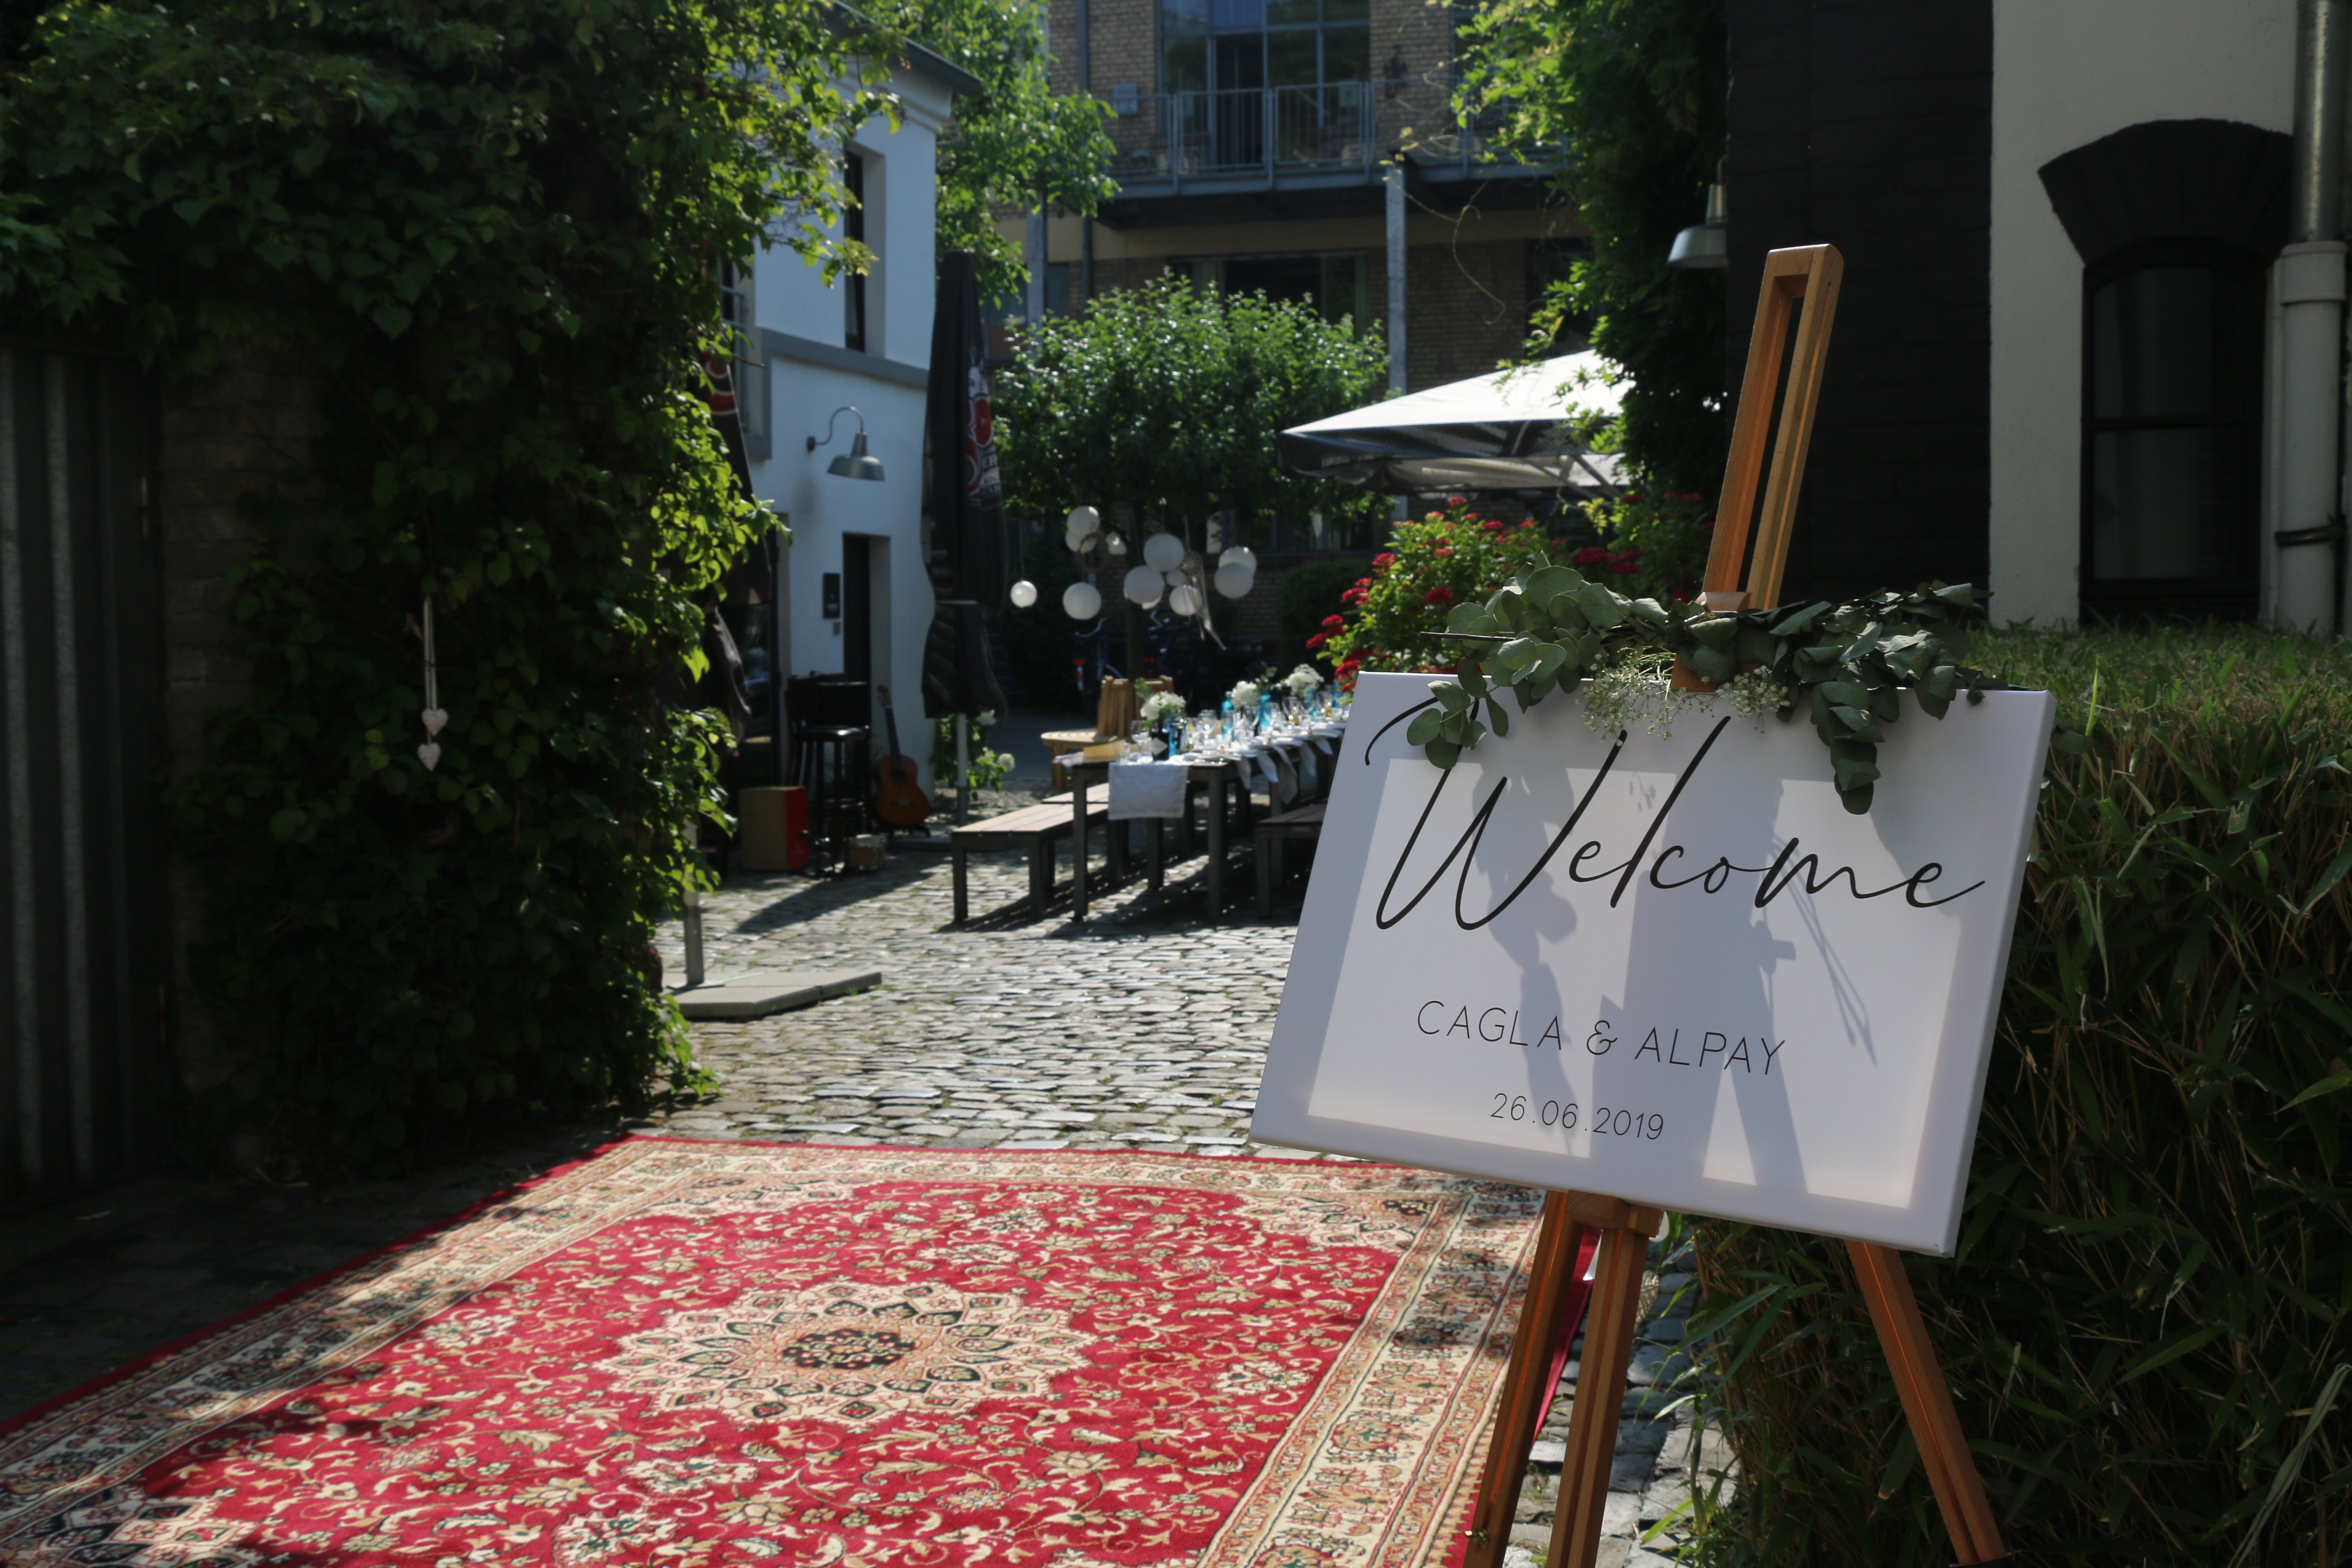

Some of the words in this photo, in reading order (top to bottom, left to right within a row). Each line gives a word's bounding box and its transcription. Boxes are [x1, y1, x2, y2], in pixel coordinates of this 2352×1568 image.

[1365, 696, 1985, 931] Welcome
[1418, 1000, 1562, 1050] CAGLA
[1586, 1020, 1618, 1055] &
[1634, 1026, 1785, 1075] ALPAY
[1490, 1093, 1663, 1140] 26.06.2019
